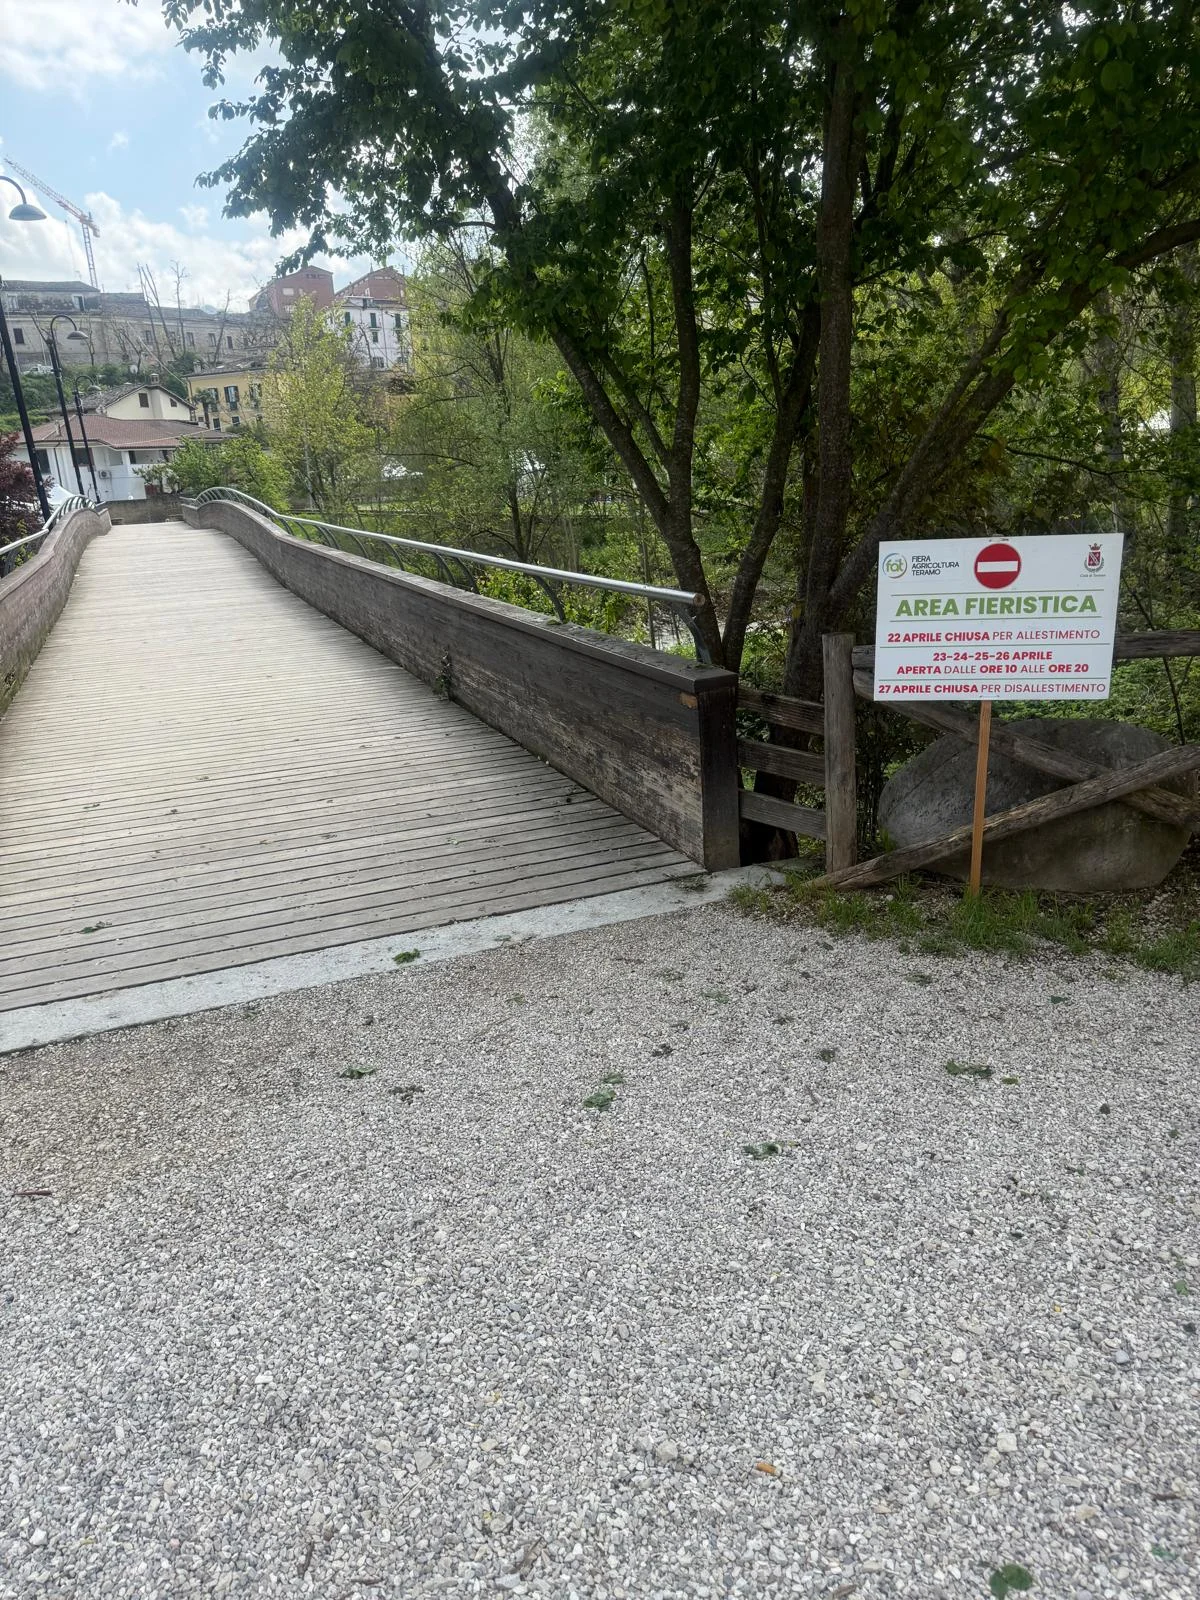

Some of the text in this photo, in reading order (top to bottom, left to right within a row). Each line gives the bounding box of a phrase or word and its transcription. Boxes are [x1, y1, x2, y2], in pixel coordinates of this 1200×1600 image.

[896, 595, 1097, 616] AREA FIERISTICA
[888, 630, 1100, 642] 22 APRILE CHIUSA PER ALLESTIMENTO
[933, 651, 1052, 661] 23-24-25-26 APRILE
[897, 664, 1088, 674] APERTA DALLE ORE 10 ALLE ORE 20
[879, 683, 1105, 694] 27 APRILE CHIUSA PER DISALLESTIMENTO
